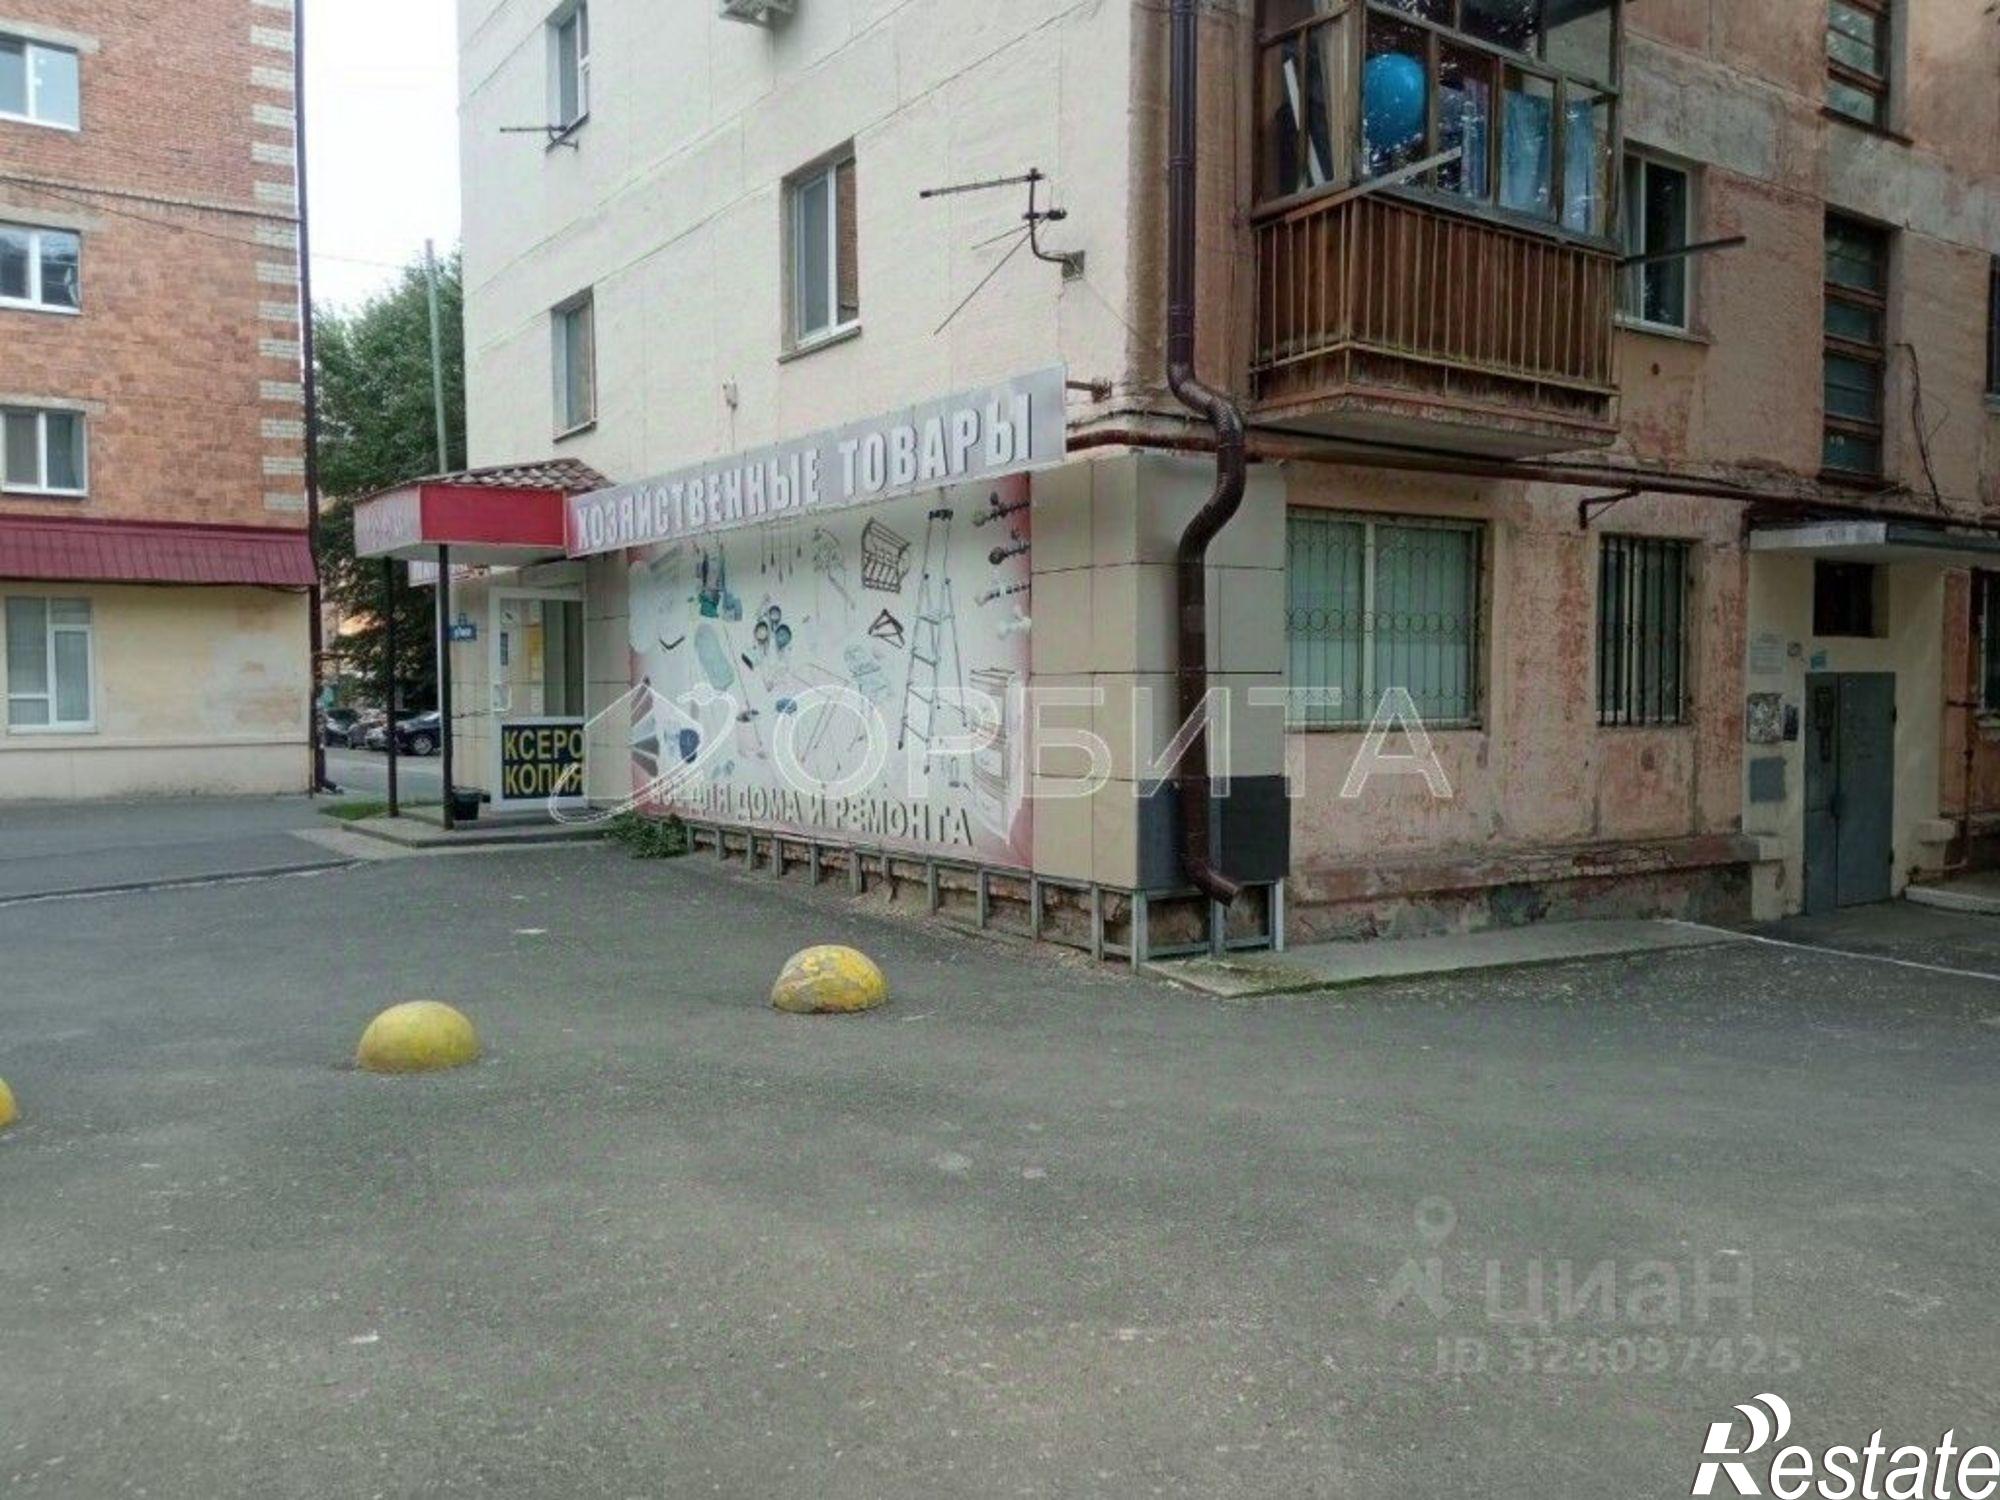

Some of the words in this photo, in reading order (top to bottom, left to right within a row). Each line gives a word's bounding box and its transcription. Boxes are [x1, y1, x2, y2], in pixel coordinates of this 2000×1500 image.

[577, 447, 820, 550] ХОЗЯЙСТВЕННЫЕ
[838, 391, 1033, 498] ТОВАРЫ
[504, 729, 585, 760] КСЕРО
[738, 785, 802, 823] ДОМА
[811, 793, 827, 825] И
[835, 796, 973, 846] РЕМОНТА
